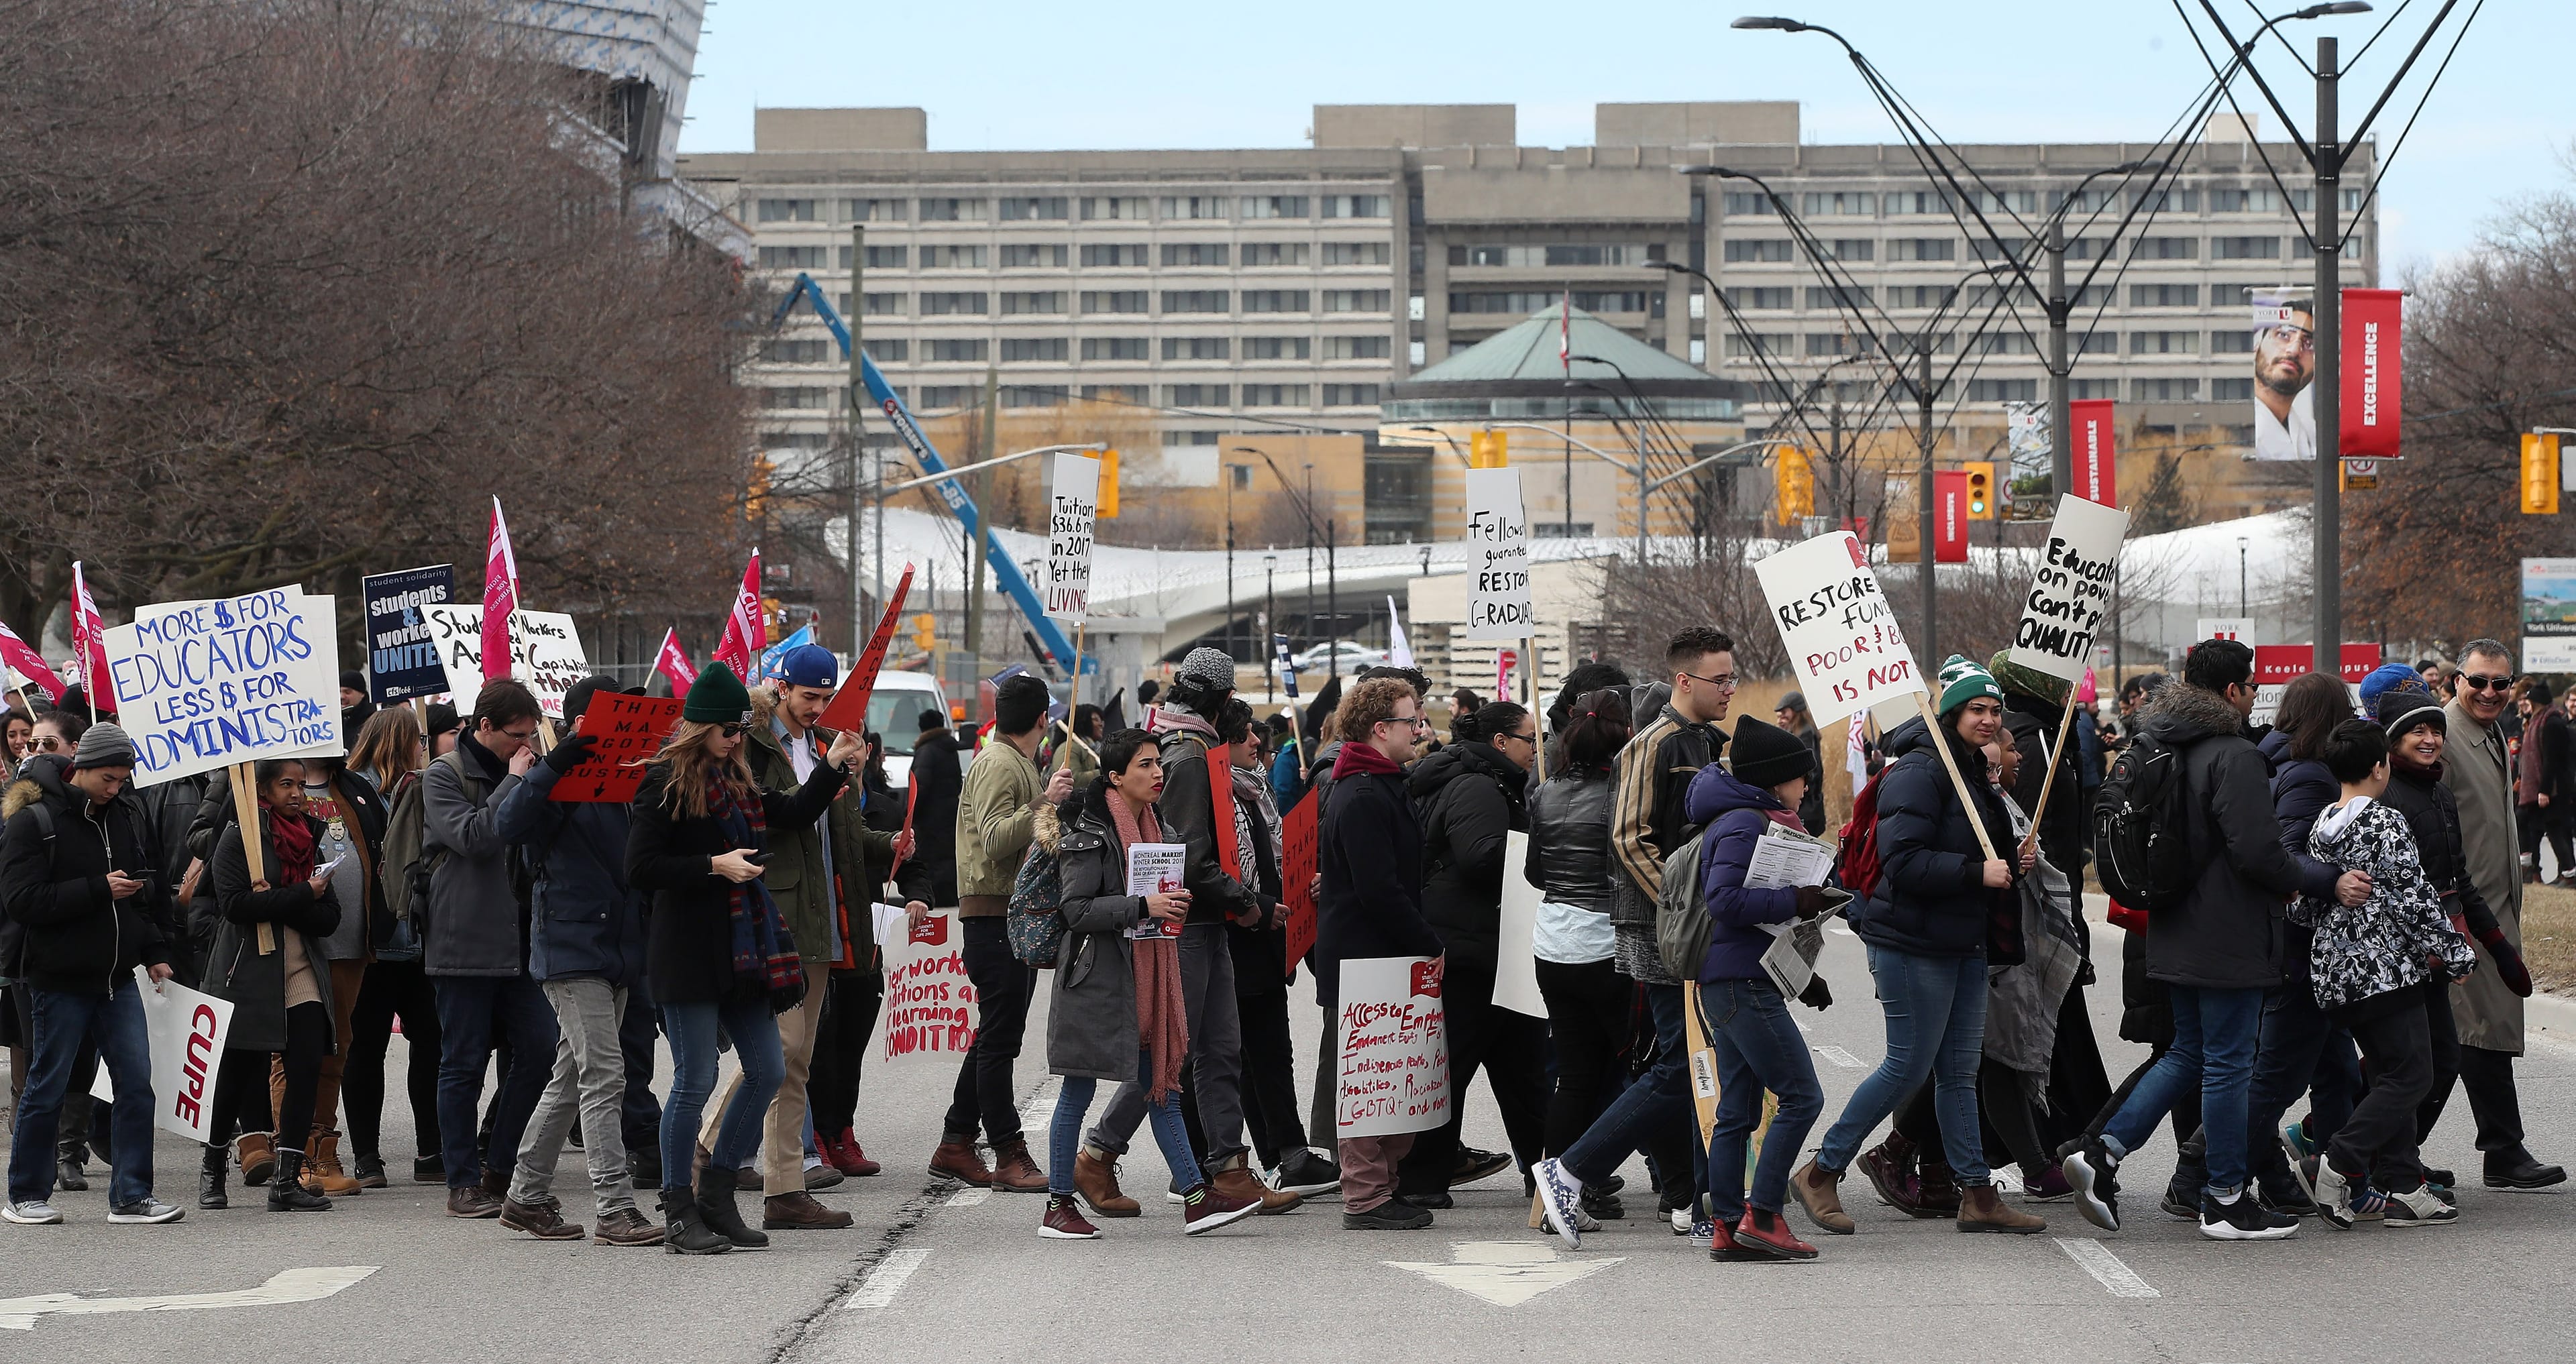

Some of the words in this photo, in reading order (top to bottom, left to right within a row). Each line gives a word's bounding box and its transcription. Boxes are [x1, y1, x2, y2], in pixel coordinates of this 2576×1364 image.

[2363, 321, 2378, 427] EXCELLENCE
[2087, 420, 2100, 502] SUSTAINABLE
[1055, 496, 1093, 518] Tuition
[1947, 492, 1955, 542] INCLUSIVE
[1053, 514, 1082, 535] $36.6
[1052, 539, 1063, 557] in
[1066, 536, 1091, 558] 2017
[370, 577, 402, 587] student
[406, 570, 447, 582] solidarity
[1049, 559, 1069, 583] Yet
[1479, 570, 1529, 592] RESTOR
[2037, 567, 2068, 590] on
[370, 585, 447, 617] students
[1049, 586, 1086, 614] LIVING
[1778, 577, 1875, 632] RESTORE
[135, 606, 211, 648] MORE
[215, 600, 235, 630] $
[237, 591, 290, 624] FOR
[402, 607, 419, 627] &
[376, 622, 431, 648] worke
[2016, 618, 2096, 665] QUALITY
[111, 615, 312, 703] EDUCATORS
[374, 642, 442, 674] UNITE
[733, 652, 745, 676] LUTTER
[1807, 636, 1870, 677] POOR
[2265, 665, 2306, 673] Keele
[1833, 679, 1858, 703] IS
[1868, 661, 1909, 691] NOT
[154, 687, 215, 726] LESS
[219, 681, 237, 712] $
[244, 672, 297, 703] FOR
[612, 699, 678, 716] THIS
[286, 721, 334, 746] TORS
[602, 738, 651, 749] GOT
[562, 768, 641, 779] BUSTE
[1286, 826, 1315, 866] STAND
[1289, 859, 1313, 889] WITH
[1290, 890, 1308, 917] CUP
[893, 1001, 969, 1029] learning
[1340, 1002, 1387, 1031] Access
[1390, 1003, 1402, 1018] to
[175, 1004, 218, 1131] CUPE
[1338, 1096, 1404, 1126] LGBTQ+
[1409, 1098, 1430, 1117] and
